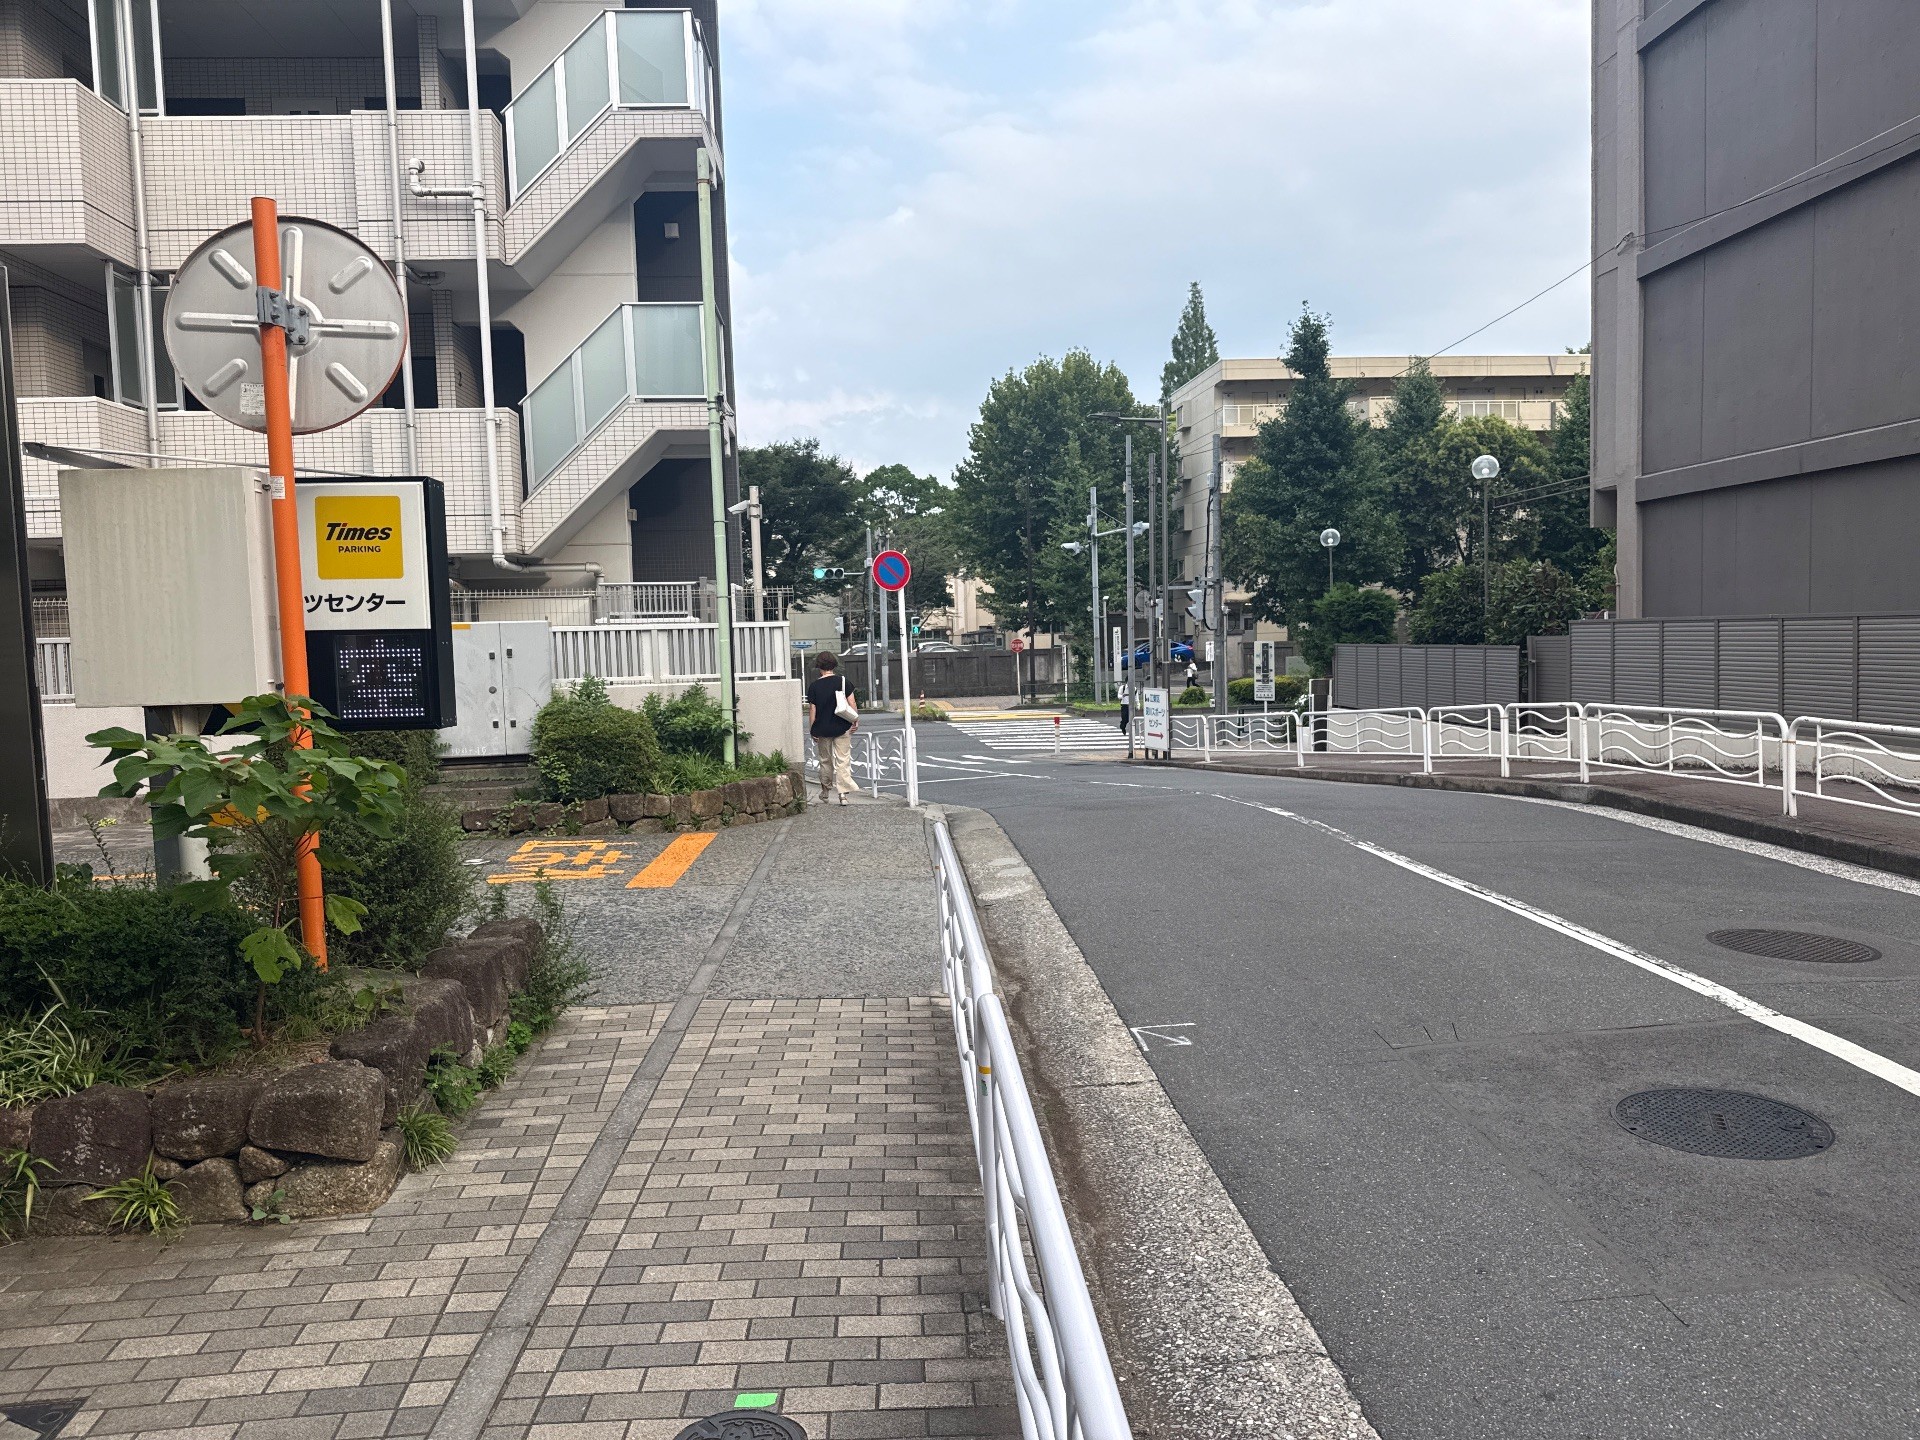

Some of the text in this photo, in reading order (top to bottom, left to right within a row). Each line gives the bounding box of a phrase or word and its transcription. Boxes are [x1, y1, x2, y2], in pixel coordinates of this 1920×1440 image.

[325, 522, 393, 541] Times
[338, 545, 381, 553] PARKING
[339, 638, 426, 719] 空
